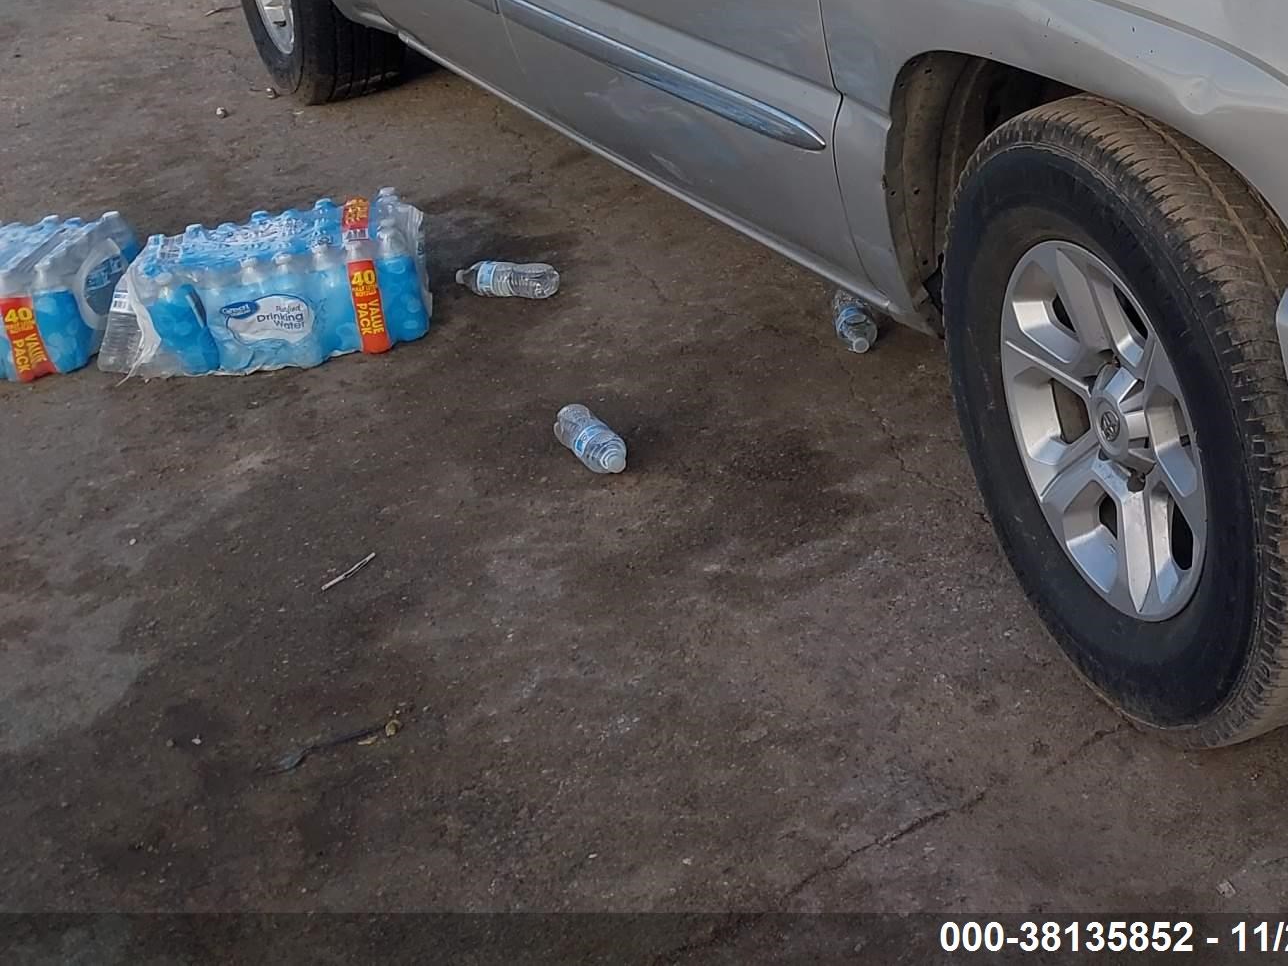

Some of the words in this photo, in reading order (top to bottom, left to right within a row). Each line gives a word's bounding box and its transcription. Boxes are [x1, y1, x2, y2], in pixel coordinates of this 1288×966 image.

[352, 270, 376, 286] 40
[5, 307, 33, 323] 40
[257, 313, 304, 322] Drinking
[356, 302, 373, 336] PACK
[368, 299, 384, 334] VALUE
[274, 320, 305, 330] Water
[13, 338, 31, 371] PACK
